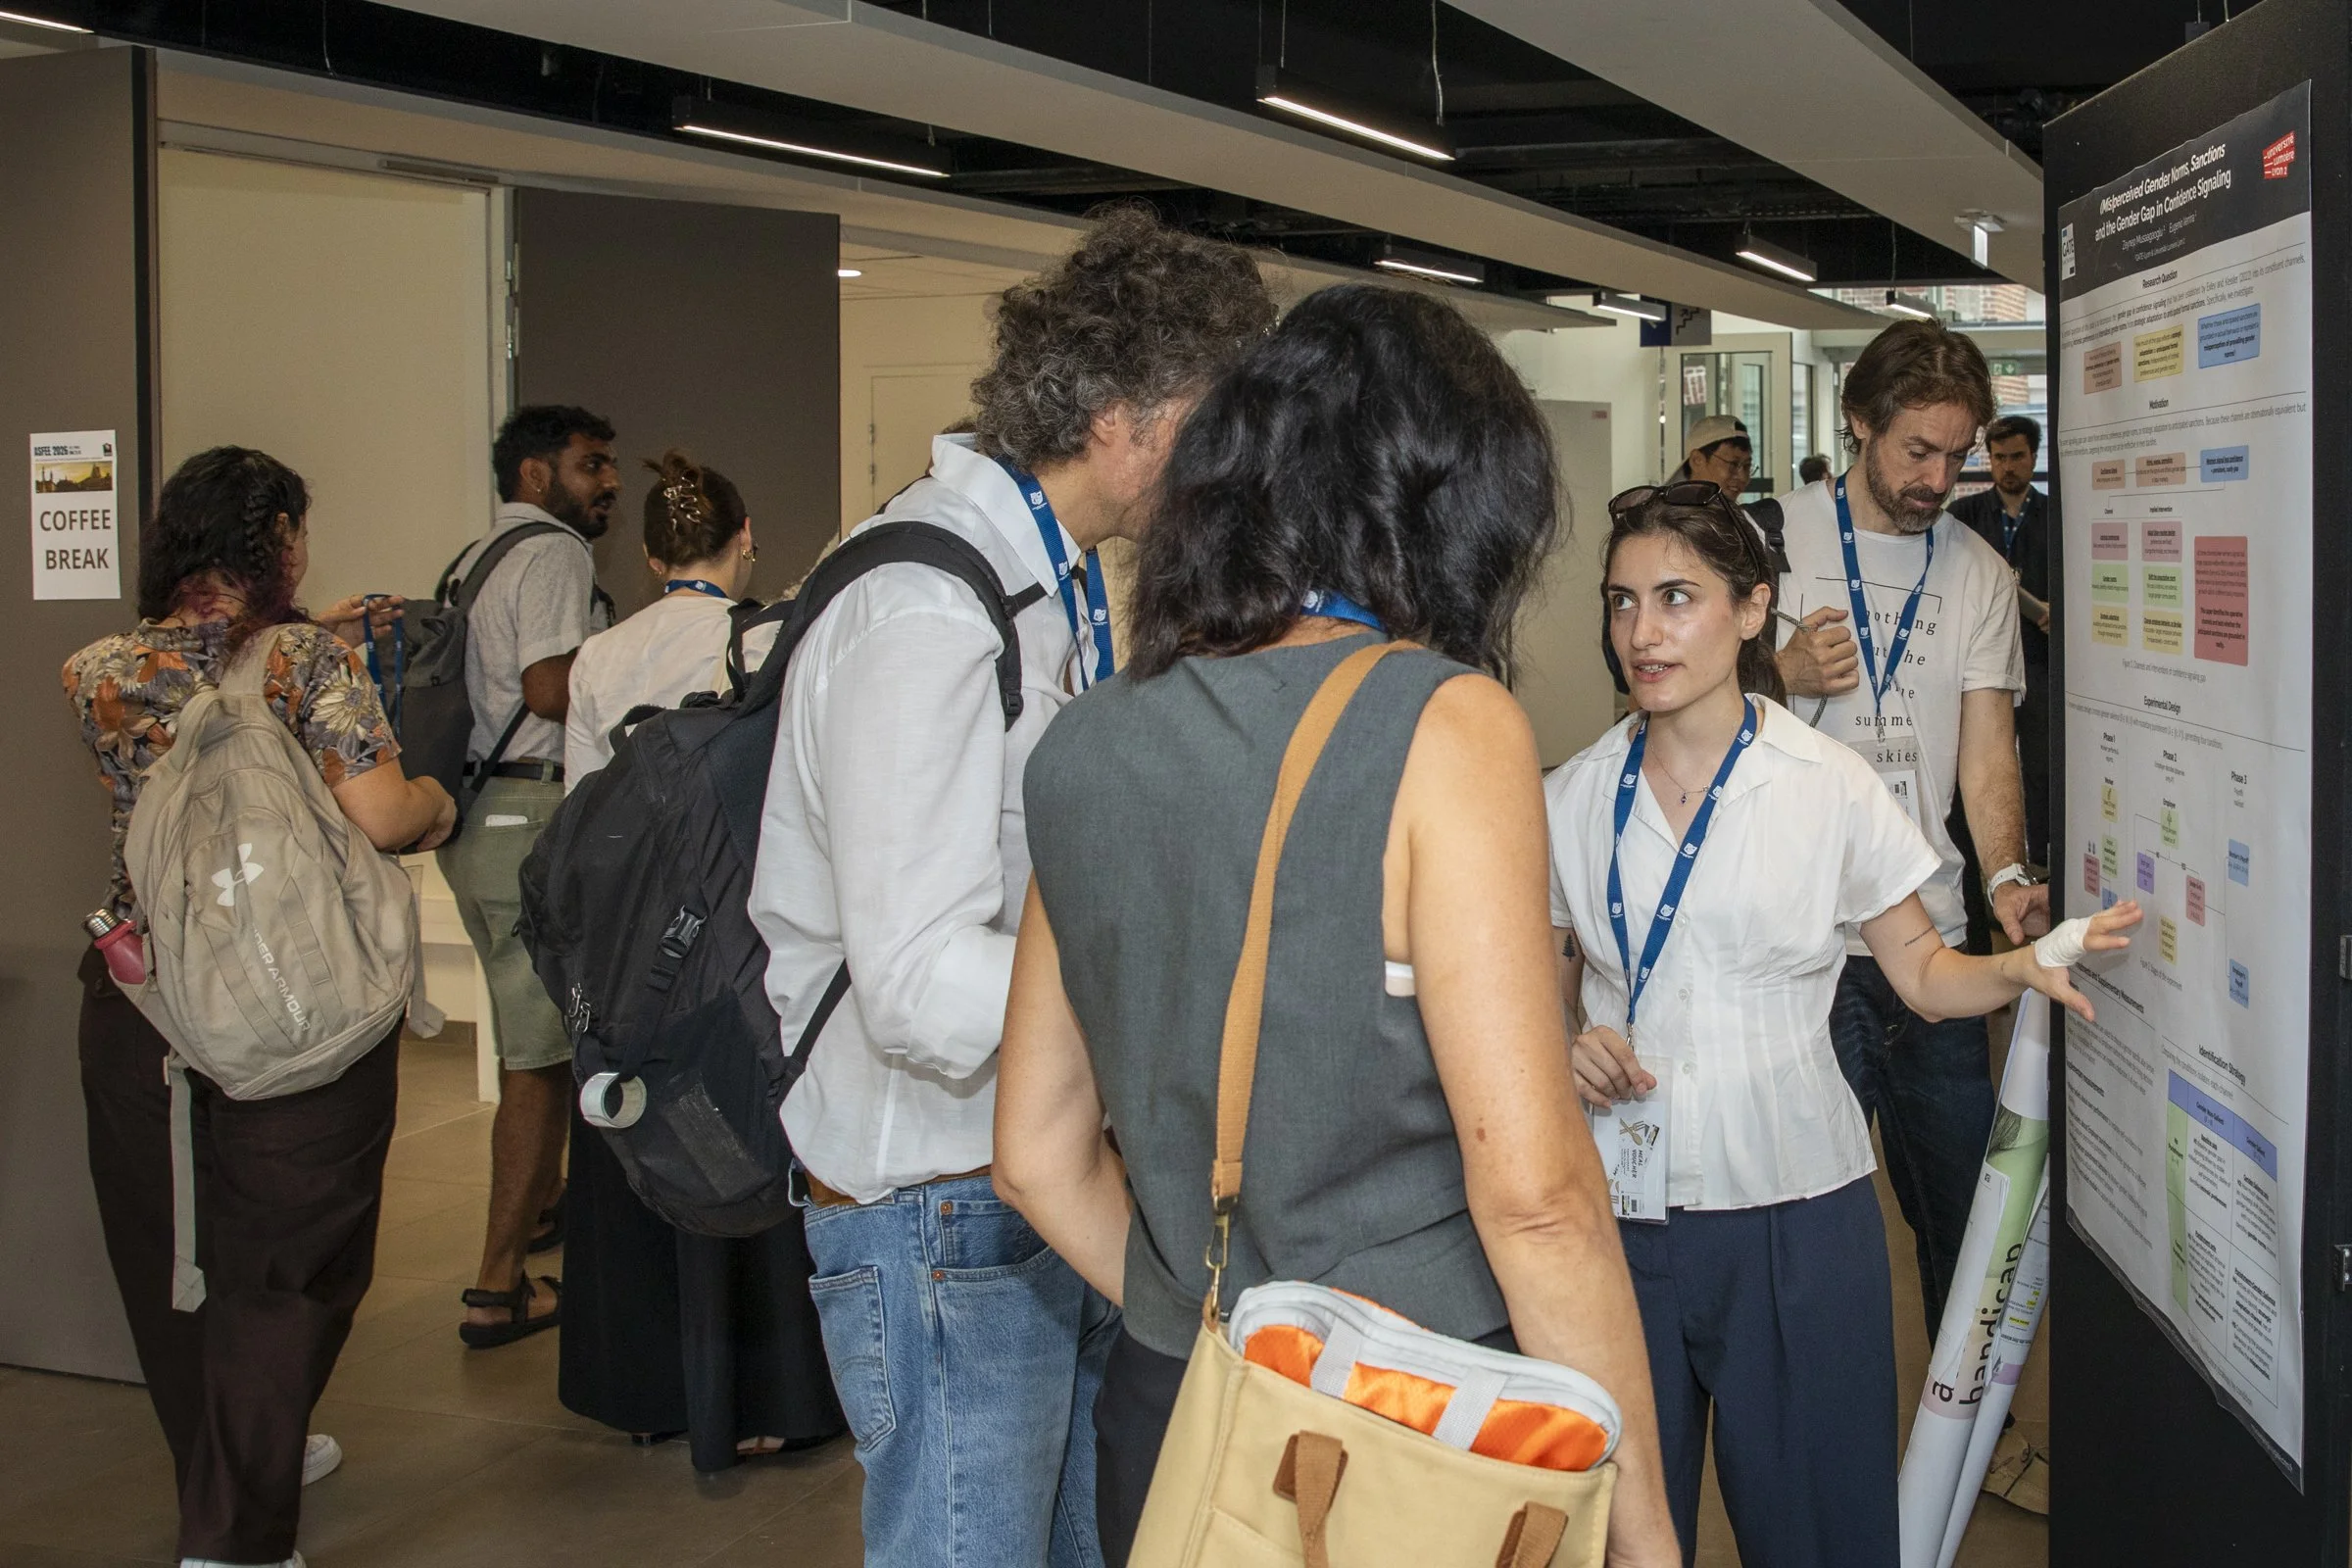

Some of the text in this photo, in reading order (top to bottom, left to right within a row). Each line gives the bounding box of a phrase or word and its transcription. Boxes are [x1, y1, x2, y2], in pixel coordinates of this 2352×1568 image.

[2144, 172, 2171, 195] Gender
[2190, 143, 2227, 172] Sanctions
[2095, 169, 2231, 241] and the Gender Gap in Confidence Signaling
[2142, 270, 2178, 288] Research Question
[2149, 397, 2169, 410] Motivation
[40, 509, 111, 532] COFFEE
[45, 548, 109, 570] BREAK
[1866, 609, 1937, 636] othng
[1903, 650, 1926, 665] he
[2144, 695, 2181, 715] Experimental Design
[2103, 731, 2113, 743] Phase
[1877, 750, 1918, 763] skies
[2162, 749, 2174, 761] Phase
[2230, 770, 2243, 784] Phase
[268, 966, 311, 1032] ARMOUR
[2198, 1044, 2246, 1087] Identification Strategy
